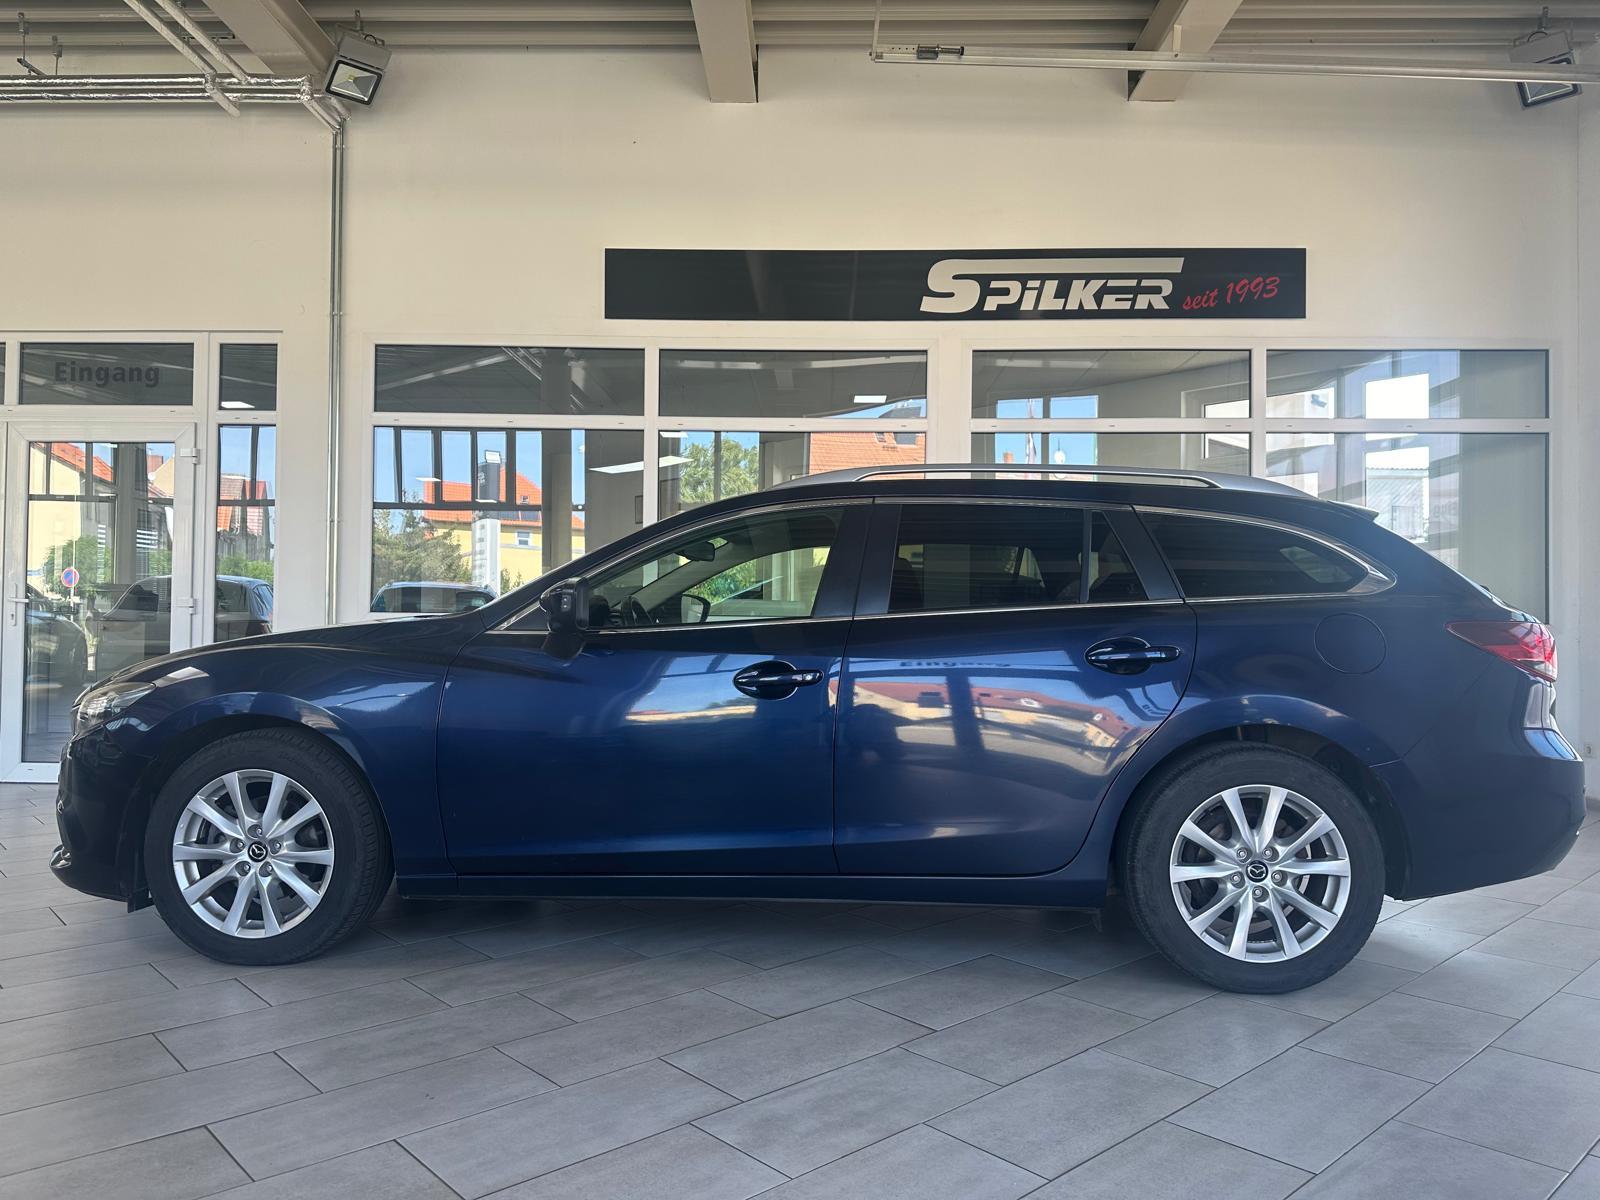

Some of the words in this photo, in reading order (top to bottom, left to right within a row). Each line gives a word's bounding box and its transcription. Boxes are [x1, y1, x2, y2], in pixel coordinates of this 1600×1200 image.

[1182, 288, 1219, 310] seit
[1226, 276, 1281, 304] 1993
[55, 361, 160, 388] Eingang
